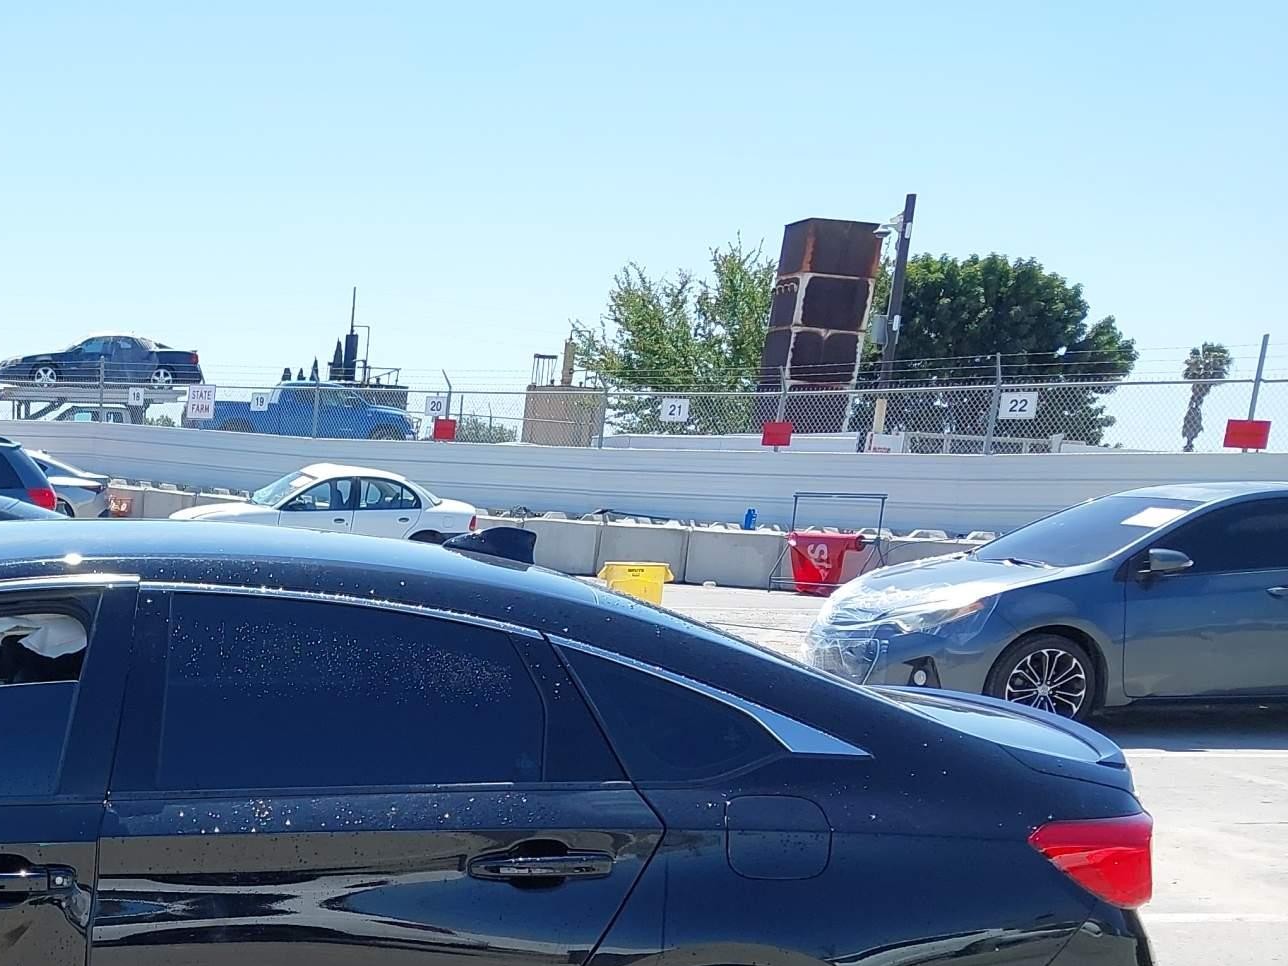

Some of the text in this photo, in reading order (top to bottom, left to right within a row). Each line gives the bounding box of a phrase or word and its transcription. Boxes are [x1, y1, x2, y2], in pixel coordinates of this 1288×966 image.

[132, 391, 141, 401] 18
[191, 389, 213, 401] STATE
[255, 397, 265, 407] 19
[430, 400, 442, 412] 20
[1009, 398, 1028, 412] 22
[190, 403, 210, 414] FARM
[668, 403, 682, 416] 21
